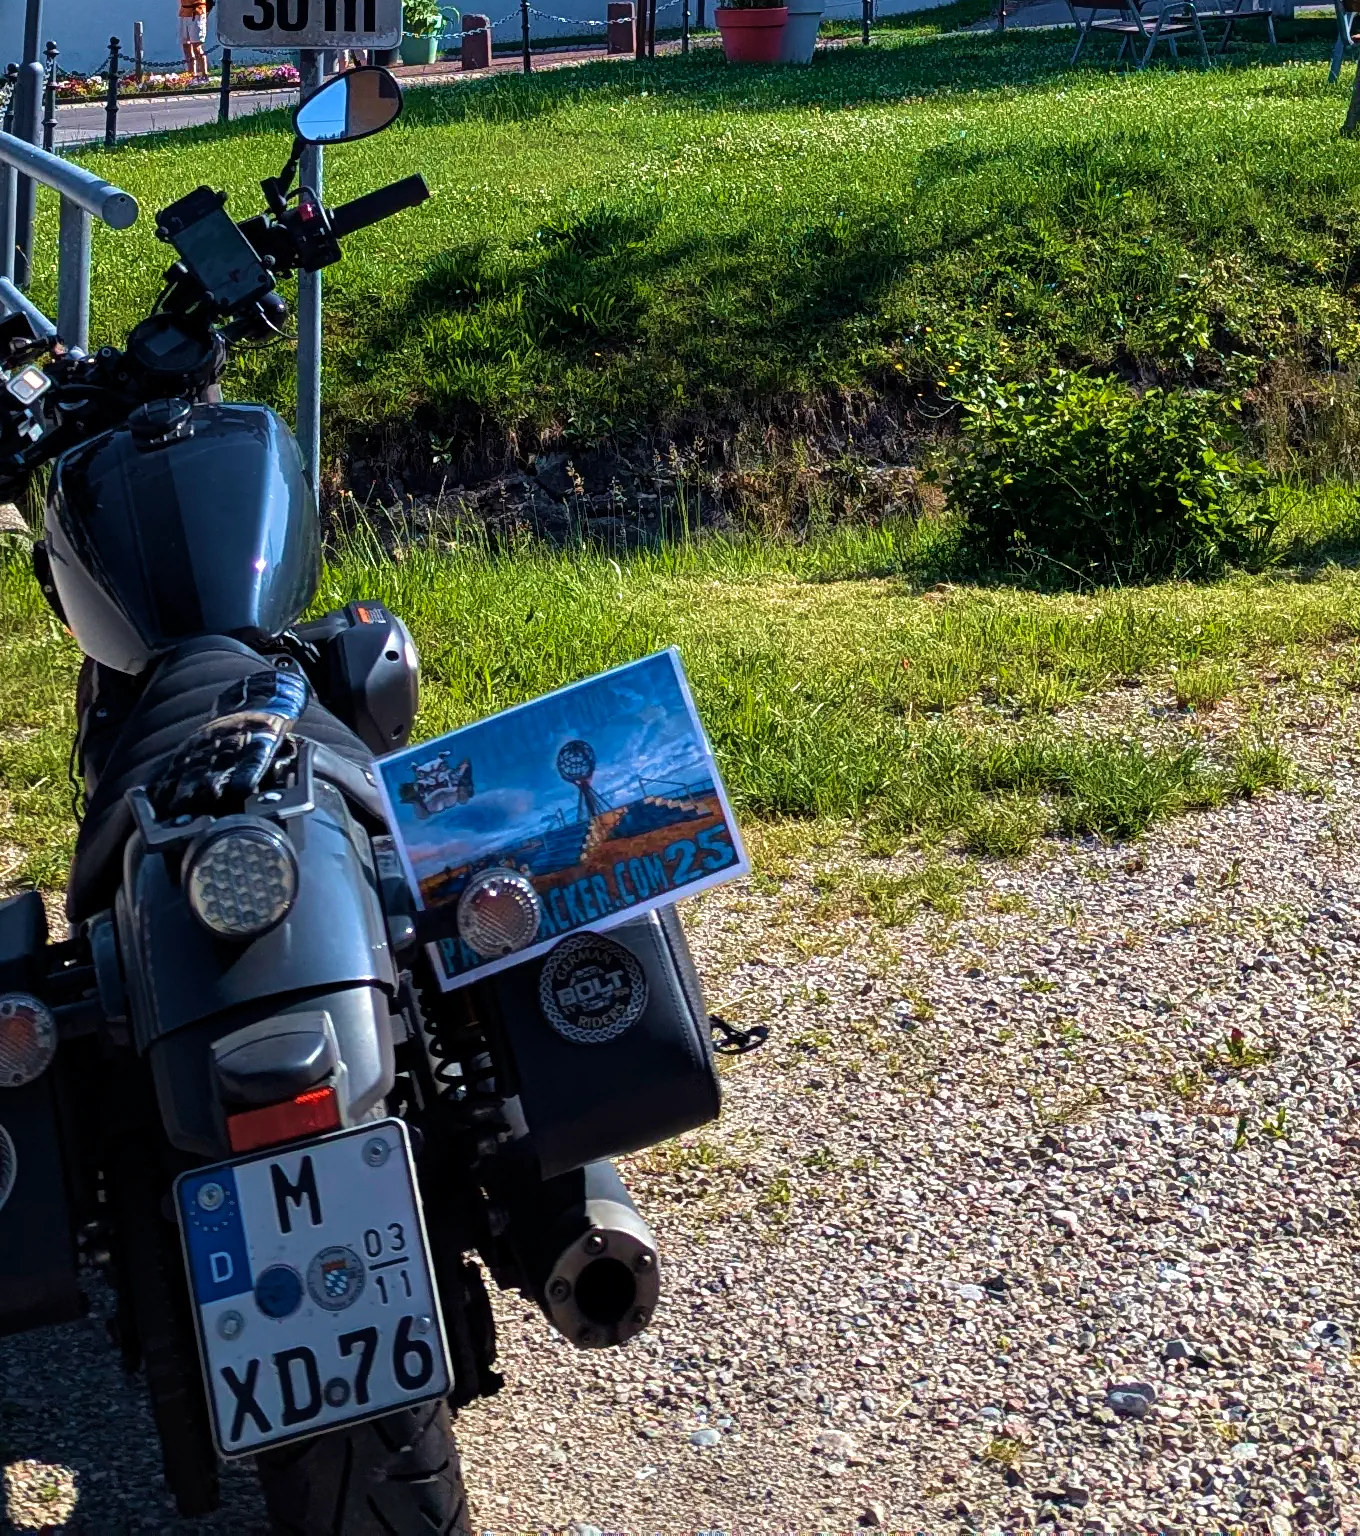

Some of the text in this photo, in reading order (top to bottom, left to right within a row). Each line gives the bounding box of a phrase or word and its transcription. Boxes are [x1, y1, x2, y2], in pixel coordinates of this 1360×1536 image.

[664, 824, 735, 886] 25
[556, 948, 612, 980] GERMAN
[556, 970, 624, 1006] BOLT
[578, 1002, 625, 1029] RIDERS
[270, 1155, 323, 1234] M
[363, 1222, 406, 1258] 03
[209, 1251, 234, 1283] D
[376, 1269, 412, 1304] 11
[220, 1315, 434, 1443] XD 76
